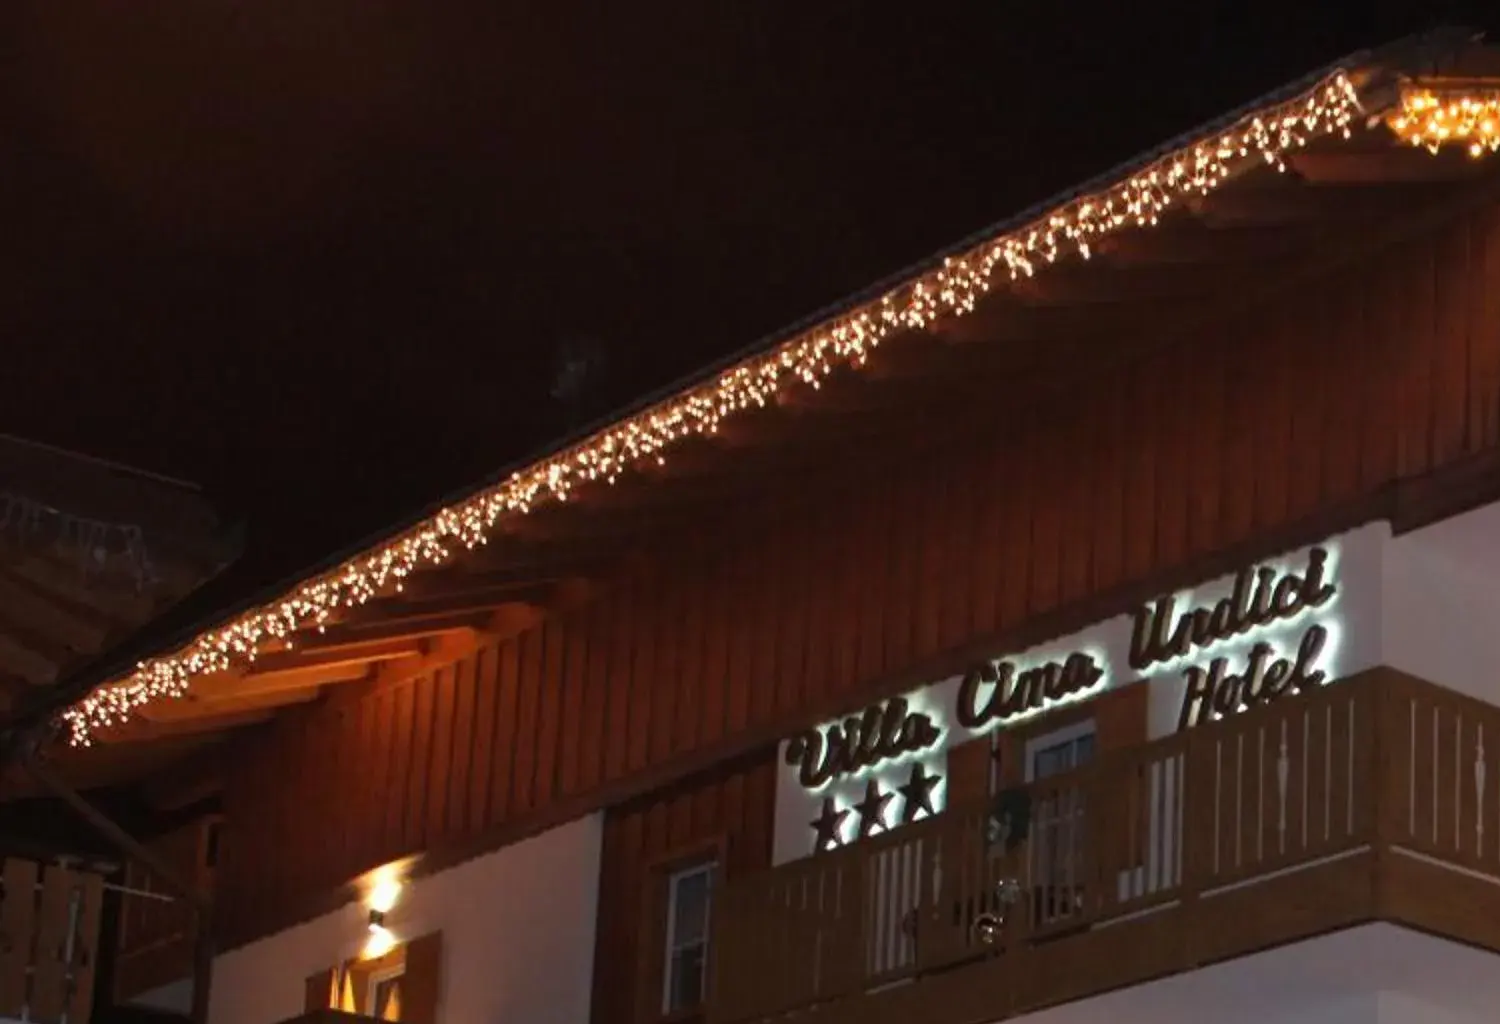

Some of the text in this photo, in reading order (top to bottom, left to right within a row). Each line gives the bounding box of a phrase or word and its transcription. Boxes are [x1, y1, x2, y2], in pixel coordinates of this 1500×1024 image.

[785, 548, 1335, 787] Villa Cima Undici
[1178, 624, 1327, 732] Hotel
